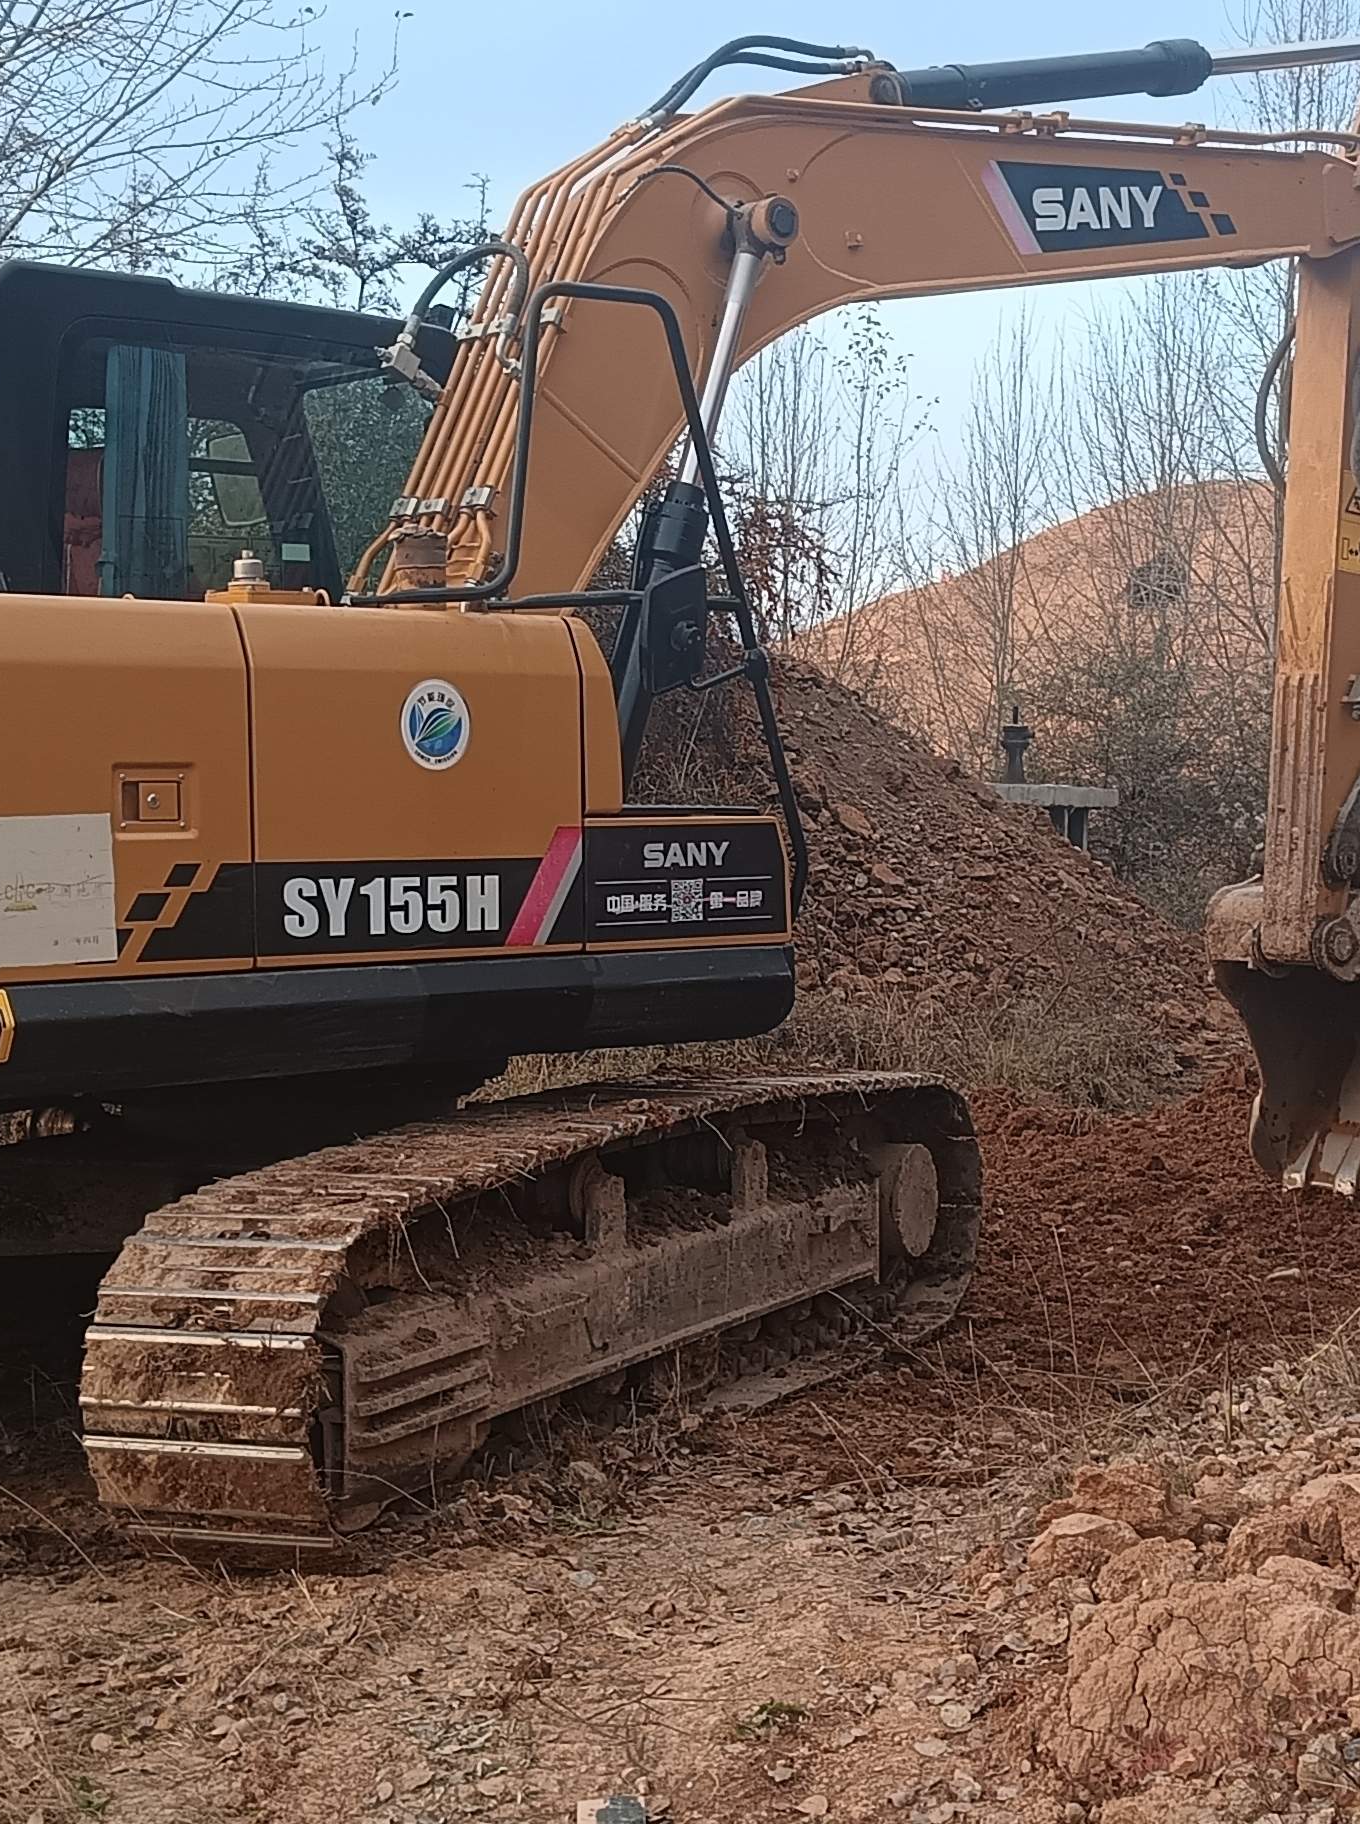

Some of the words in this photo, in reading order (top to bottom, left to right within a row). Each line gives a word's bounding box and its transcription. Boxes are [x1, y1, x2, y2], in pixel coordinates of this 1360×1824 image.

[1032, 185, 1163, 232] SANY
[643, 841, 730, 868] SANY
[283, 875, 500, 937] SY155H
